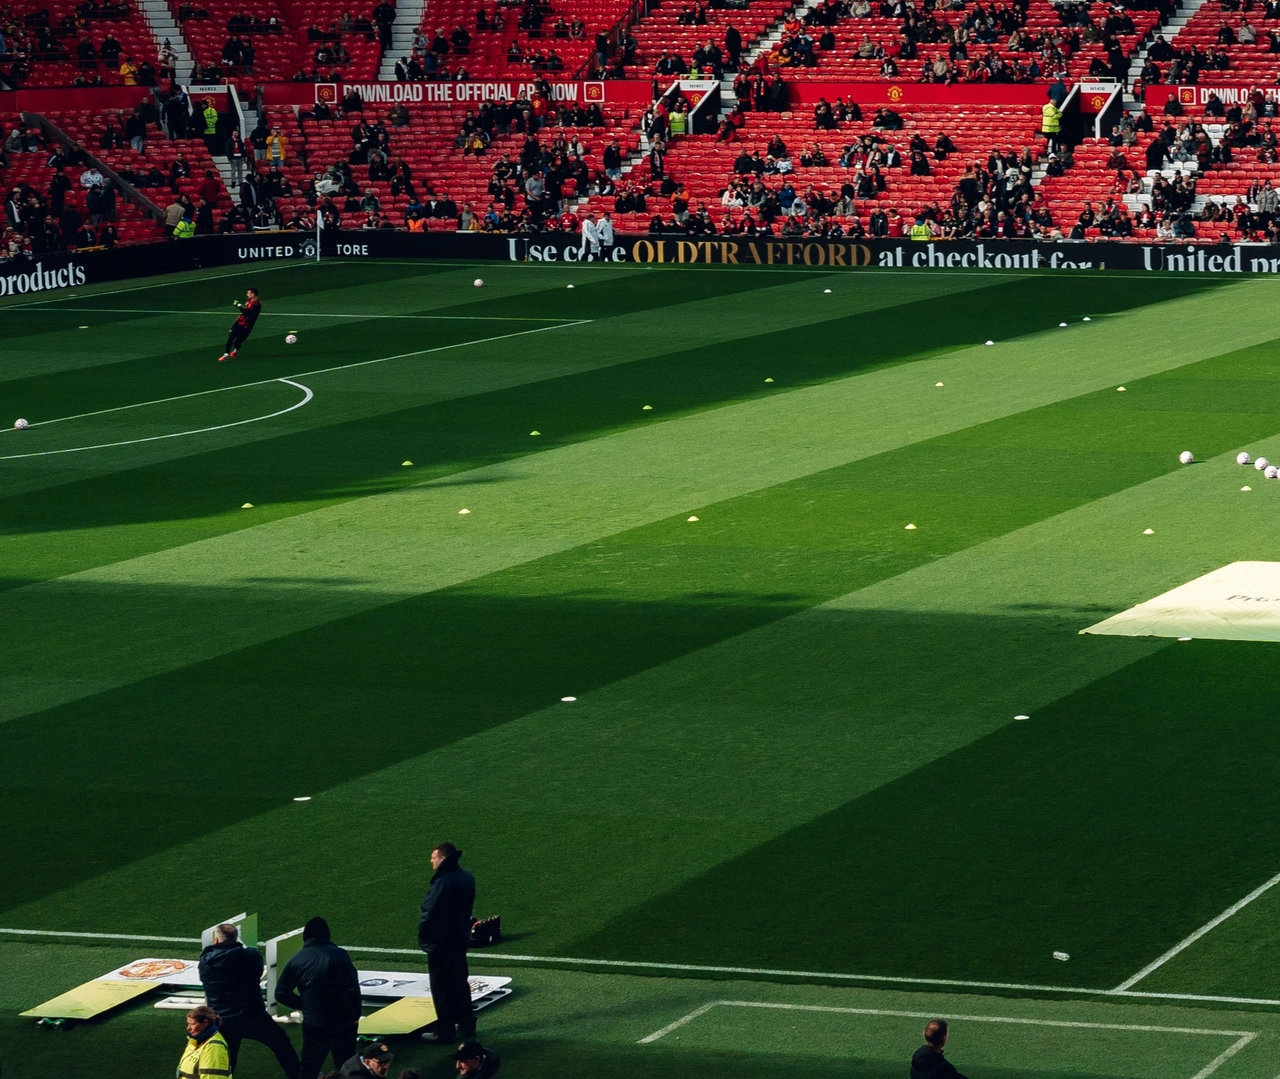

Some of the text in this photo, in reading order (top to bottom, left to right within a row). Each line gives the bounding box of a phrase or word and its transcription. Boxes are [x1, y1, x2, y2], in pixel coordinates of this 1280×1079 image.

[425, 83, 454, 102] THE
[456, 83, 515, 101] OFFICIAL
[518, 83, 538, 101] AP
[549, 83, 578, 101] NOW
[1200, 88, 1264, 105] DWNLO
[237, 245, 294, 259] UNITED
[335, 243, 369, 256] TORE
[506, 238, 558, 262] Use
[632, 239, 871, 266] OLDTRAFFORD
[878, 245, 906, 267] at
[912, 242, 1041, 269] checkout
[1048, 250, 1092, 269] for
[1141, 245, 1242, 273] United
